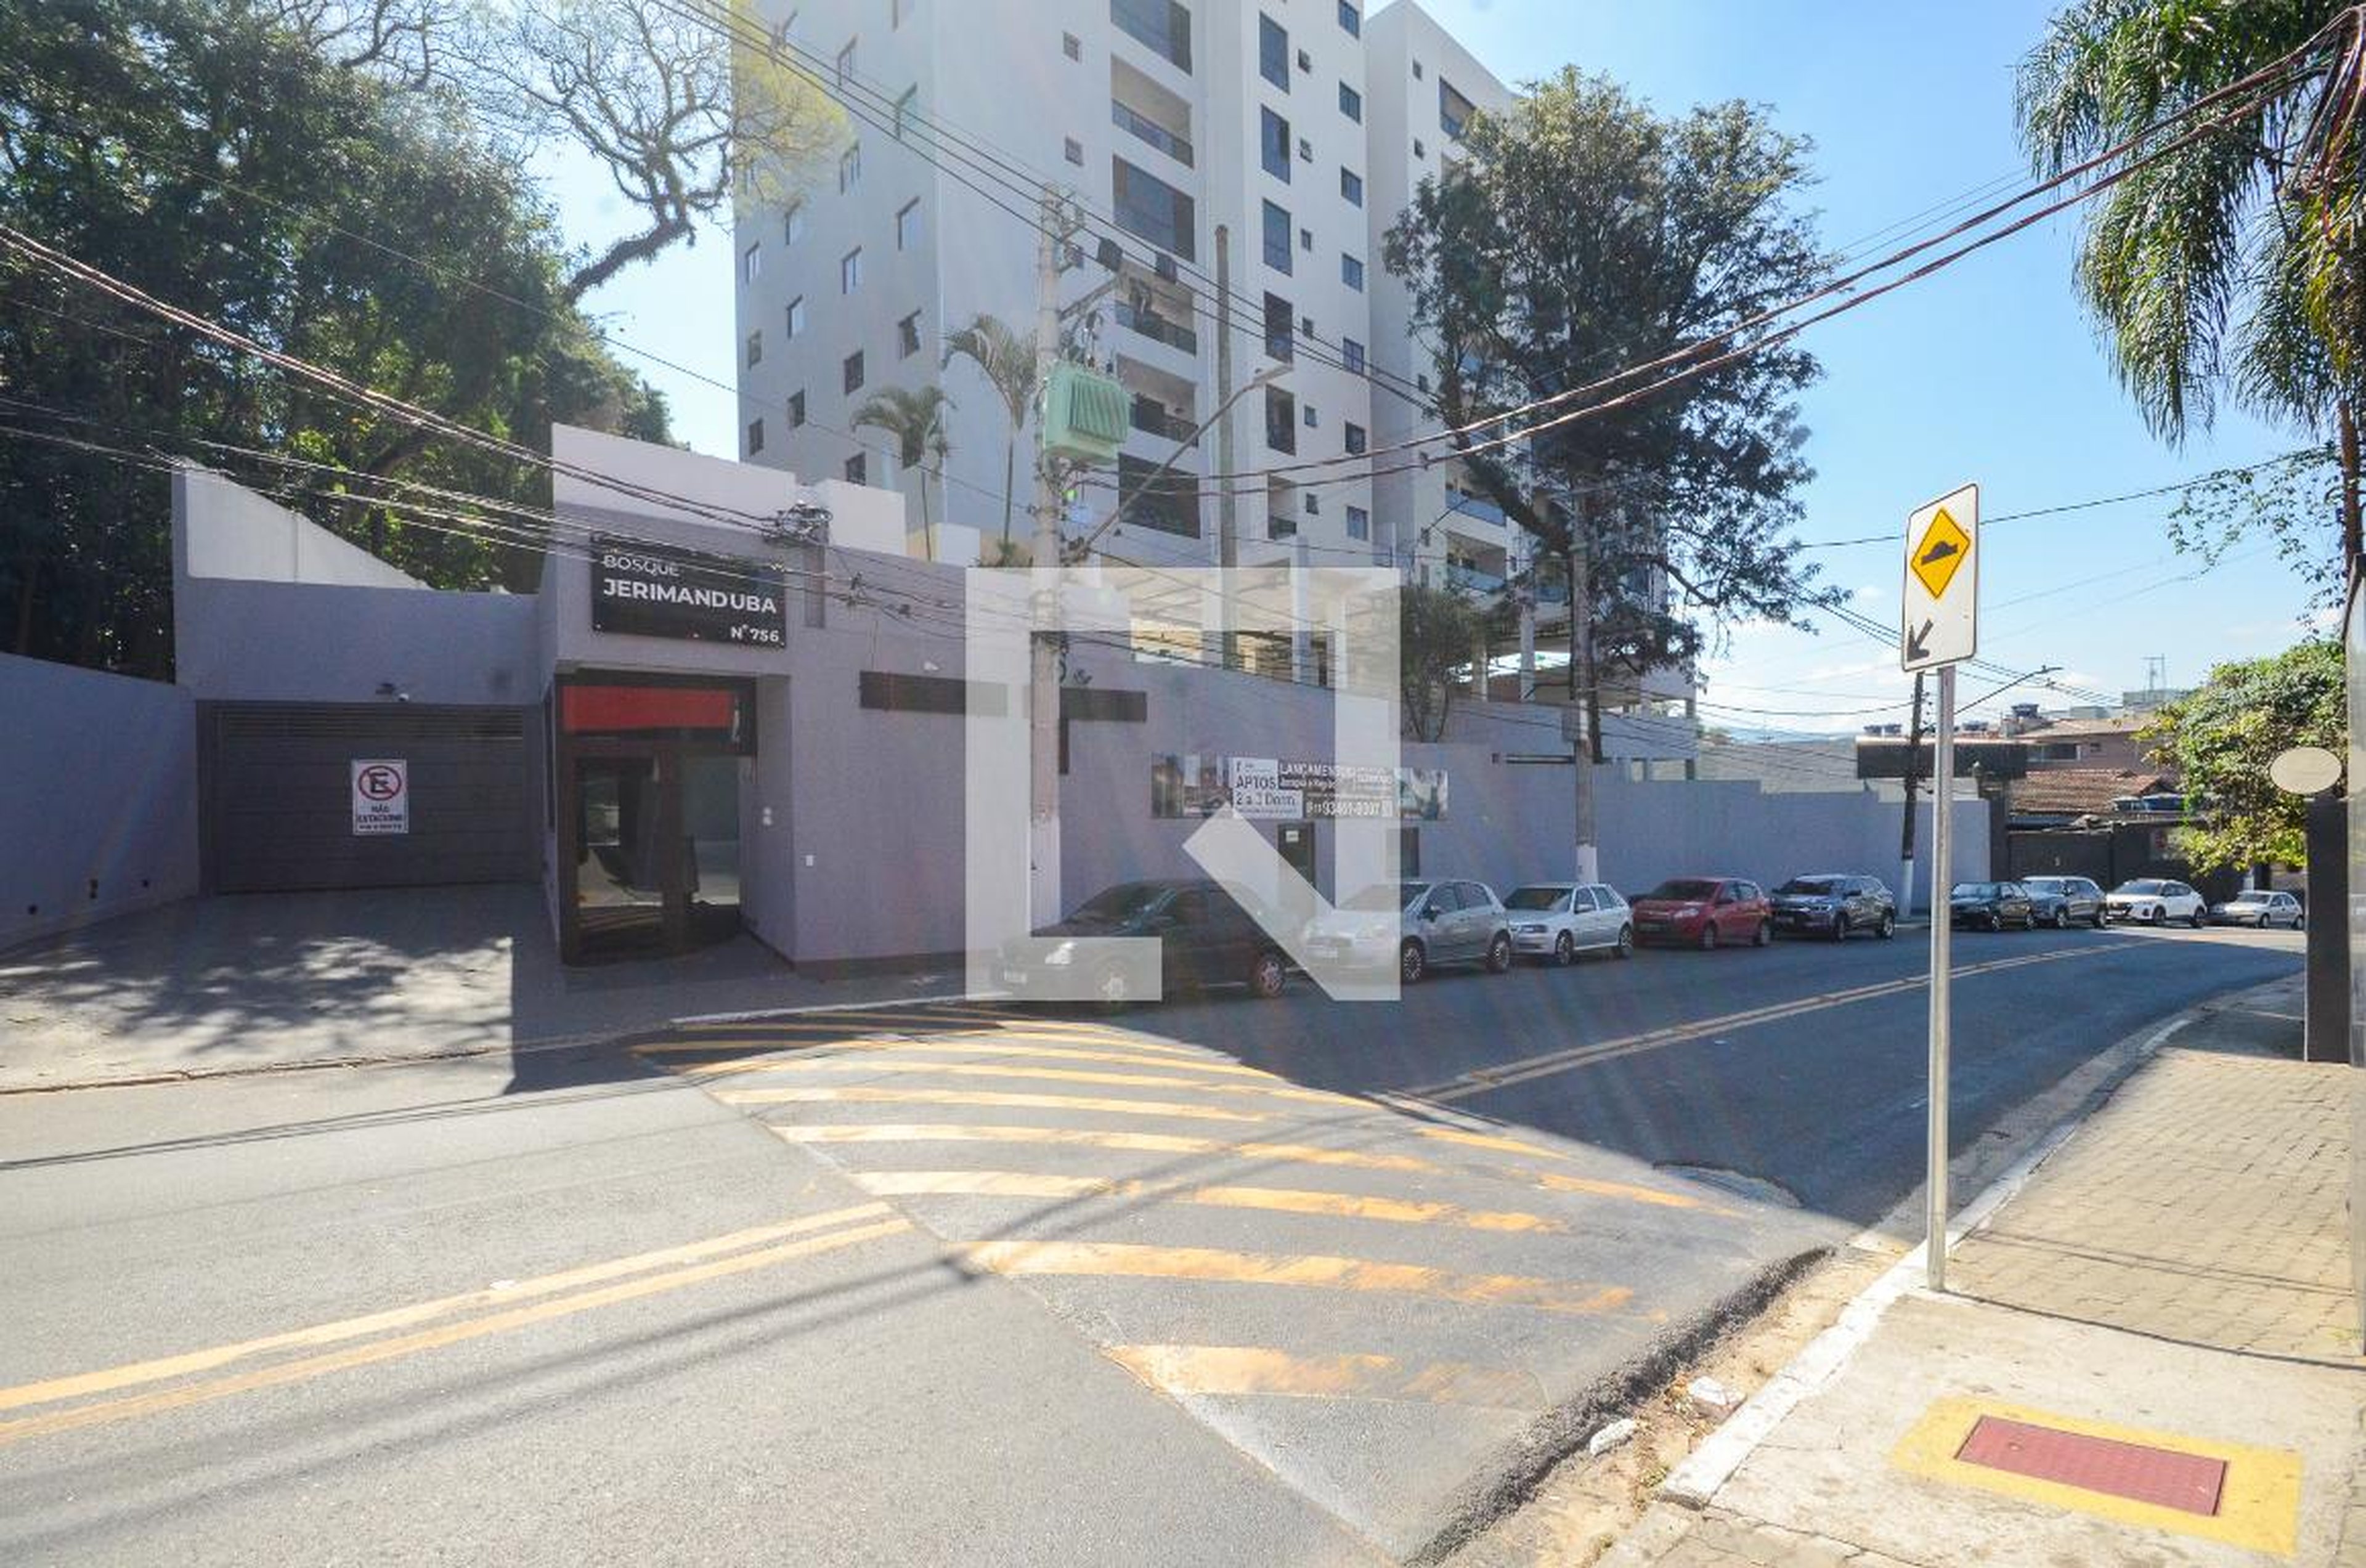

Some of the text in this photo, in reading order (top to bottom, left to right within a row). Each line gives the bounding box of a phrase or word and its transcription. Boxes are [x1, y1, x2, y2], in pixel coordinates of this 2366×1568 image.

[603, 554, 680, 577] BOSQUE
[603, 578, 777, 614] JERIMANDUBA
[750, 628, 779, 643] 756
